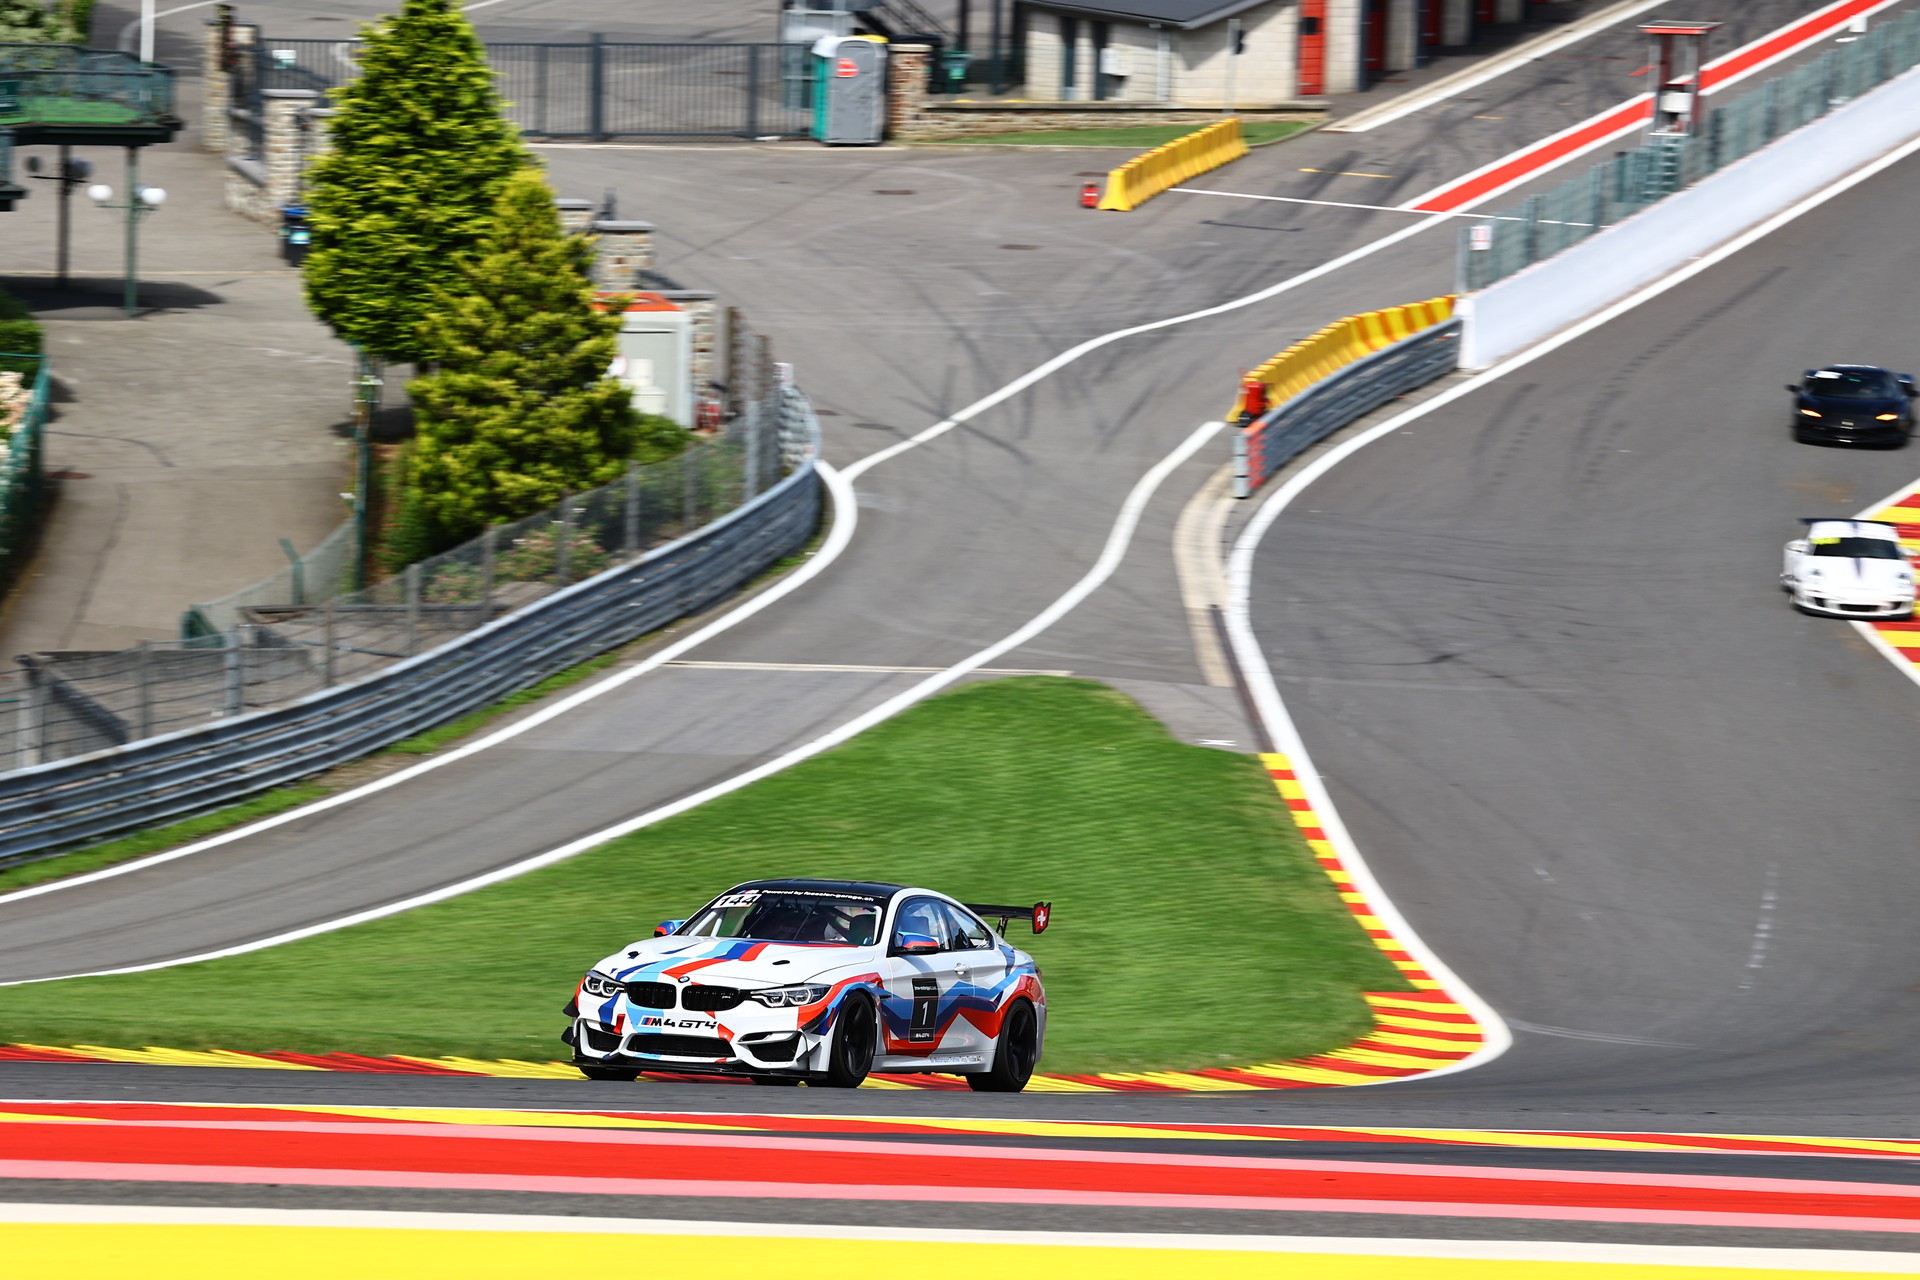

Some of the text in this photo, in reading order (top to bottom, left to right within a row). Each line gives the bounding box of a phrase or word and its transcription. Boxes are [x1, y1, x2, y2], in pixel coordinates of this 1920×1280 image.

[719, 895, 758, 906] 144
[922, 1000, 928, 1026] 1
[678, 1019, 717, 1029] GT4
